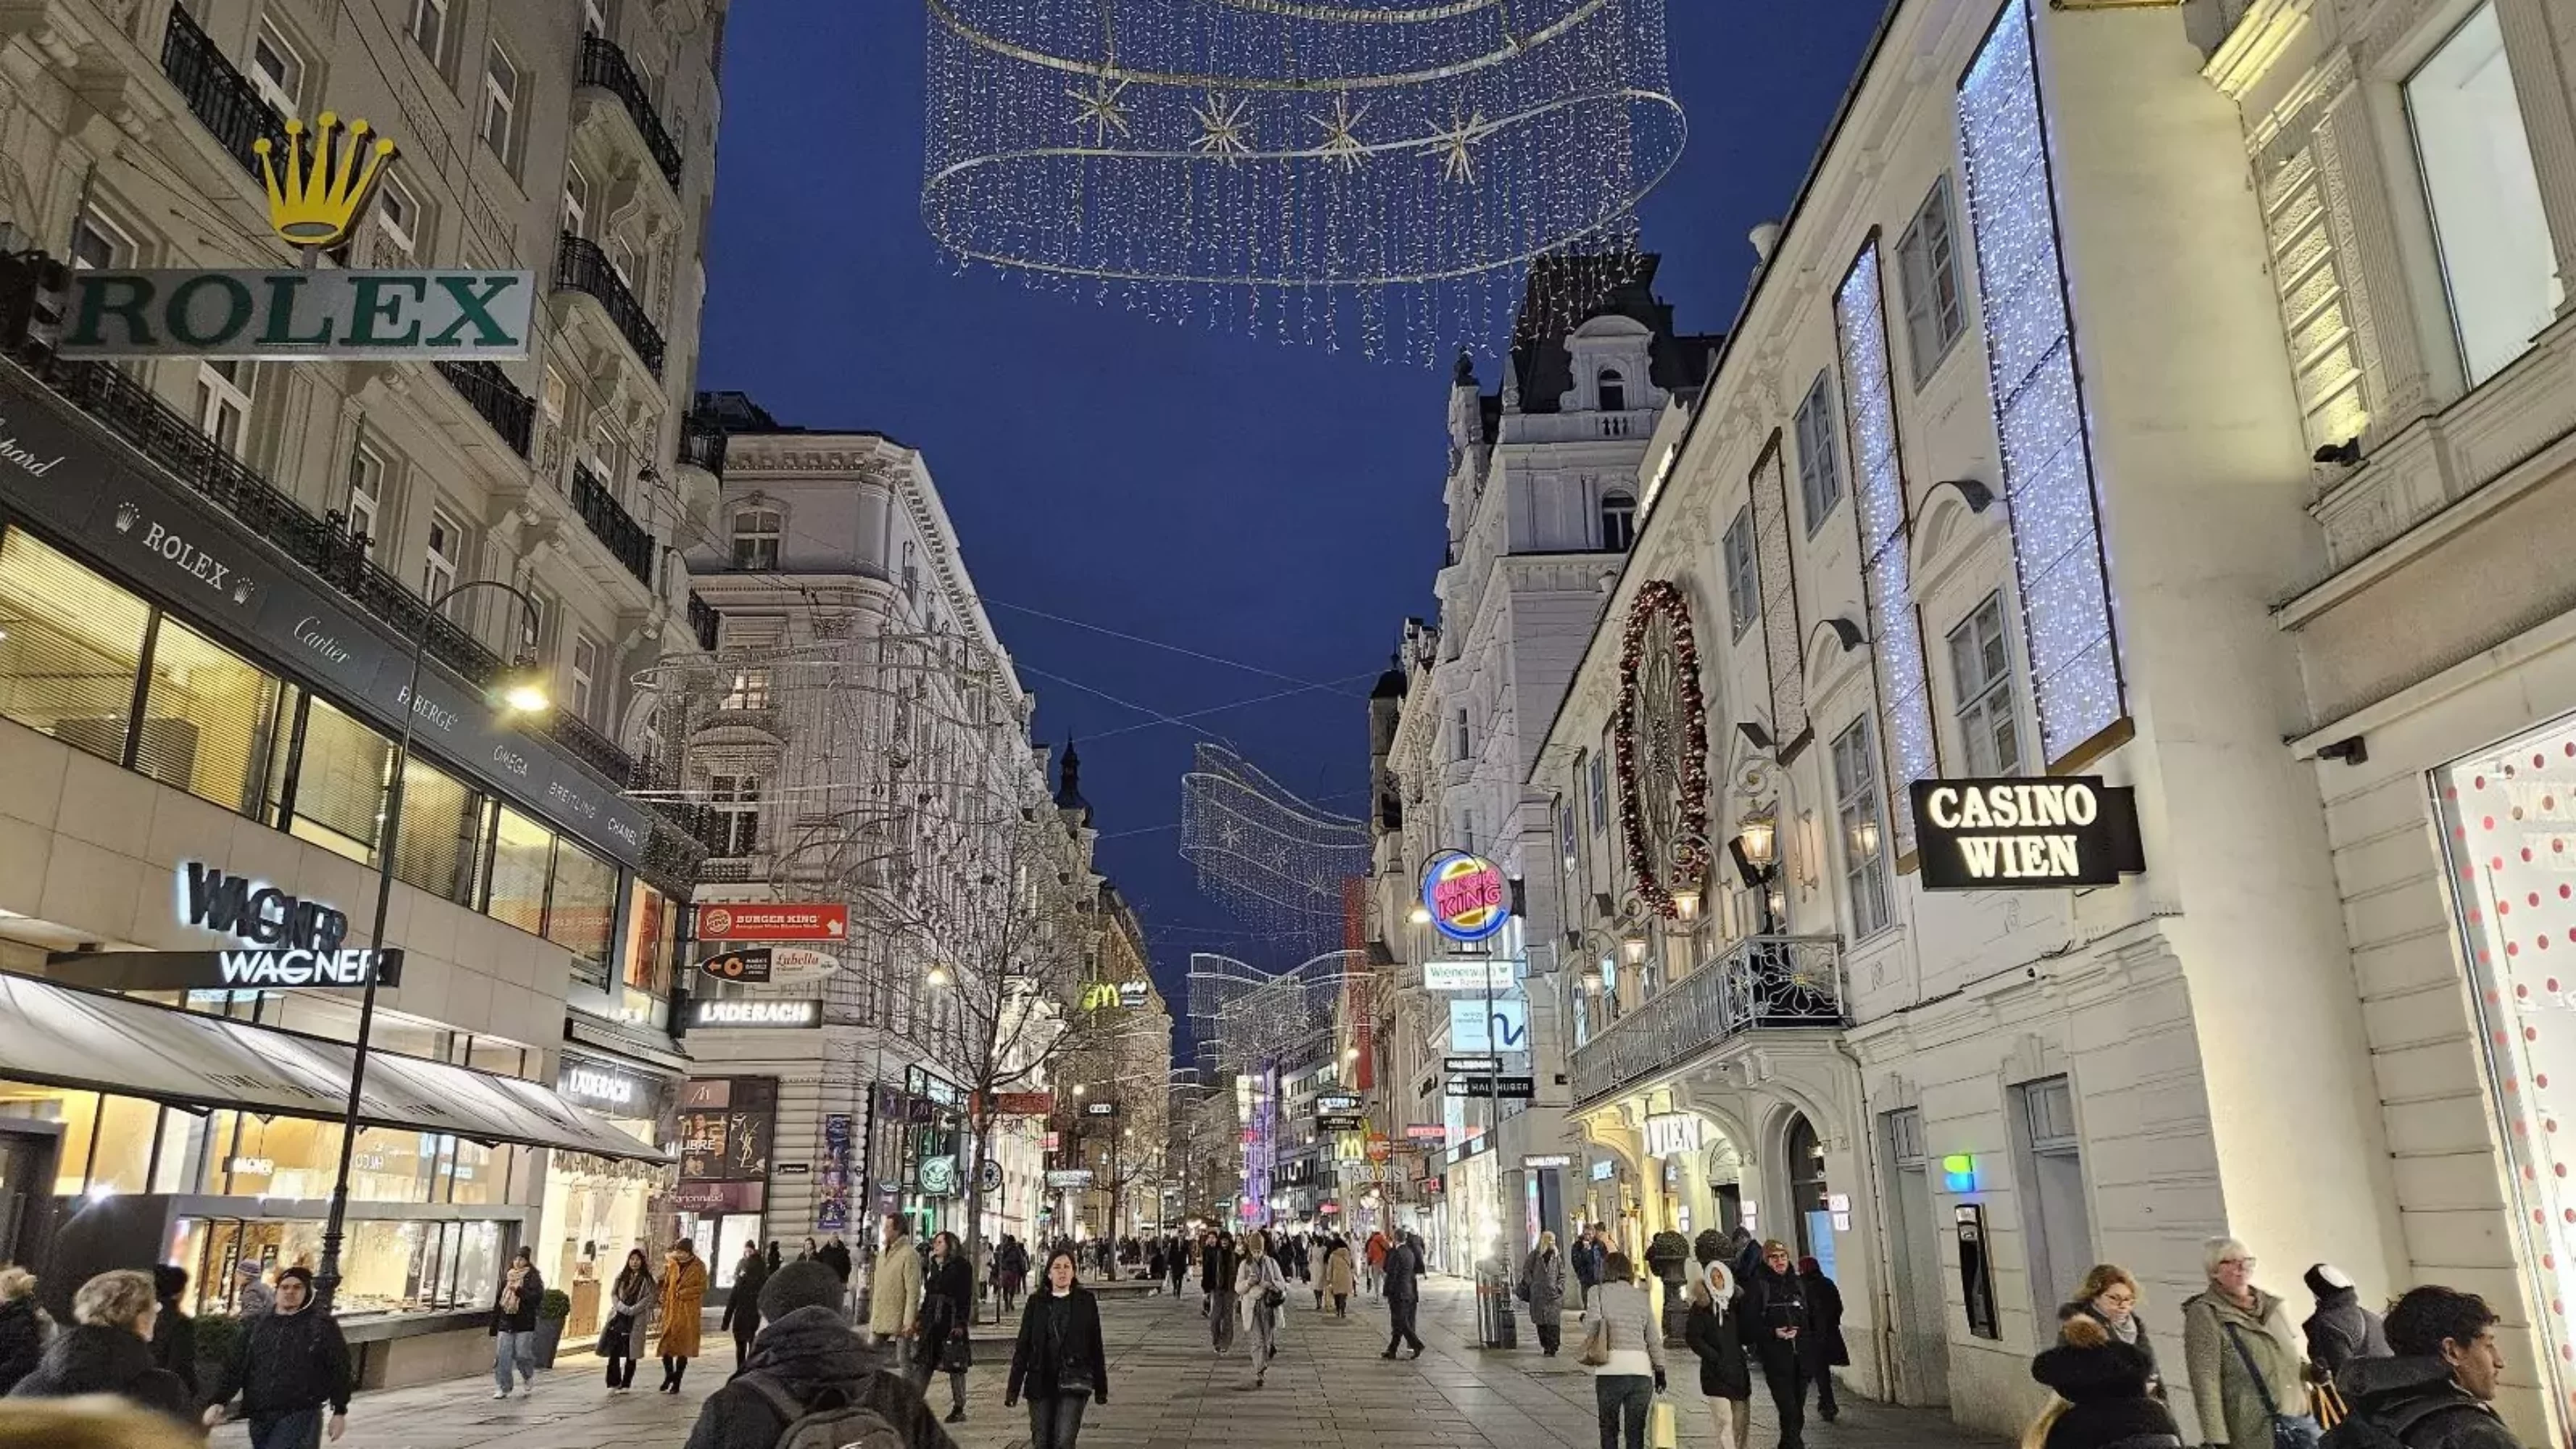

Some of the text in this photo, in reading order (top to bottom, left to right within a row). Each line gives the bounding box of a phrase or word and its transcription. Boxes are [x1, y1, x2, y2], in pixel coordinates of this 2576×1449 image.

[62, 274, 520, 347] ROLEX
[143, 521, 230, 590] ROLEX
[293, 616, 351, 663] Cartier
[397, 685, 458, 732] FBERGÉ
[493, 744, 528, 778] OMEGA
[549, 781, 596, 819] BREITLING
[1928, 783, 2098, 830] CASINO
[607, 817, 637, 846] CHANEL
[1957, 835, 2079, 879] WIEN
[1435, 869, 1499, 899] BURGER
[735, 915, 817, 924] BURGER KING
[1438, 885, 1501, 922] KING
[220, 949, 383, 984] WAGNER
[1430, 966, 1496, 977] Wienerwad
[681, 1139, 717, 1151] LIBRE
